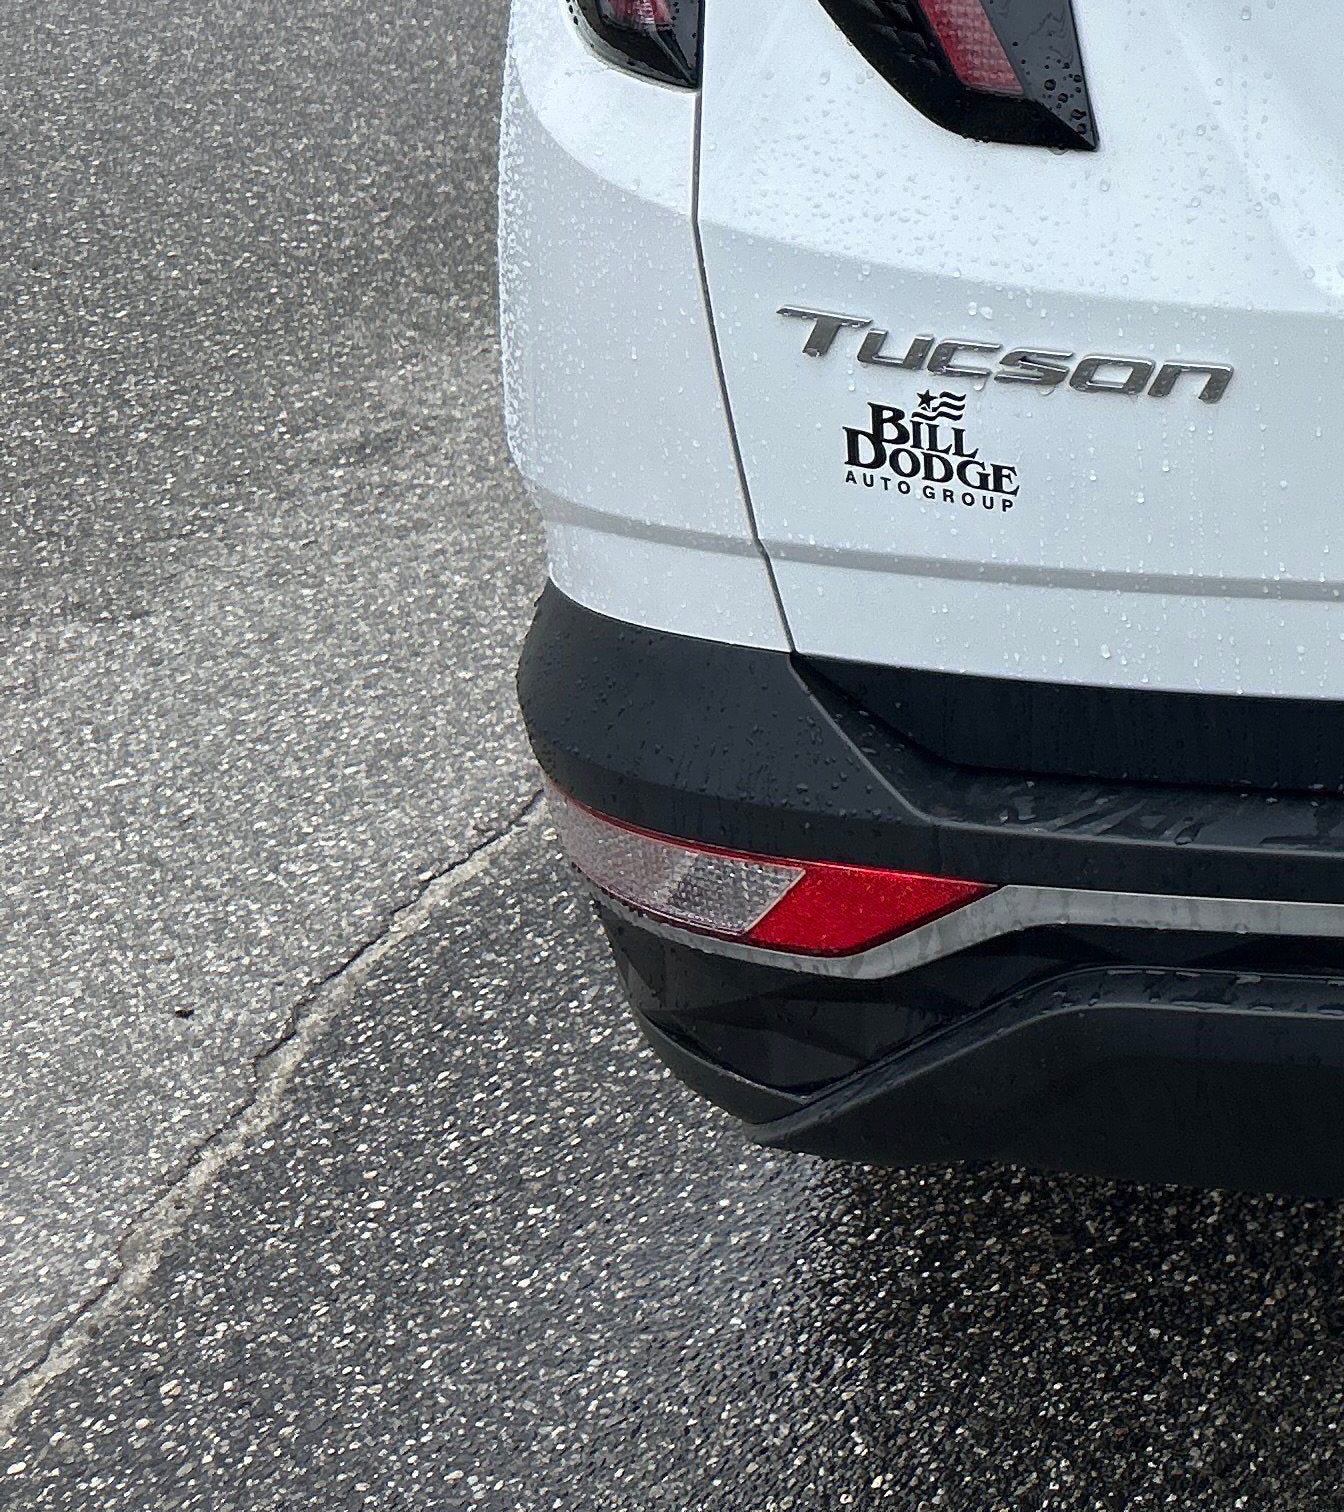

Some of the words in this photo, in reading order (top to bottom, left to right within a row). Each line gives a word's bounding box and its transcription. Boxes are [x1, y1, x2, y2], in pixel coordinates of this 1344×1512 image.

[868, 402, 979, 459] BILL
[842, 425, 1020, 496] DODGE
[845, 470, 911, 494] AUTO
[923, 485, 1013, 512] GROUP
